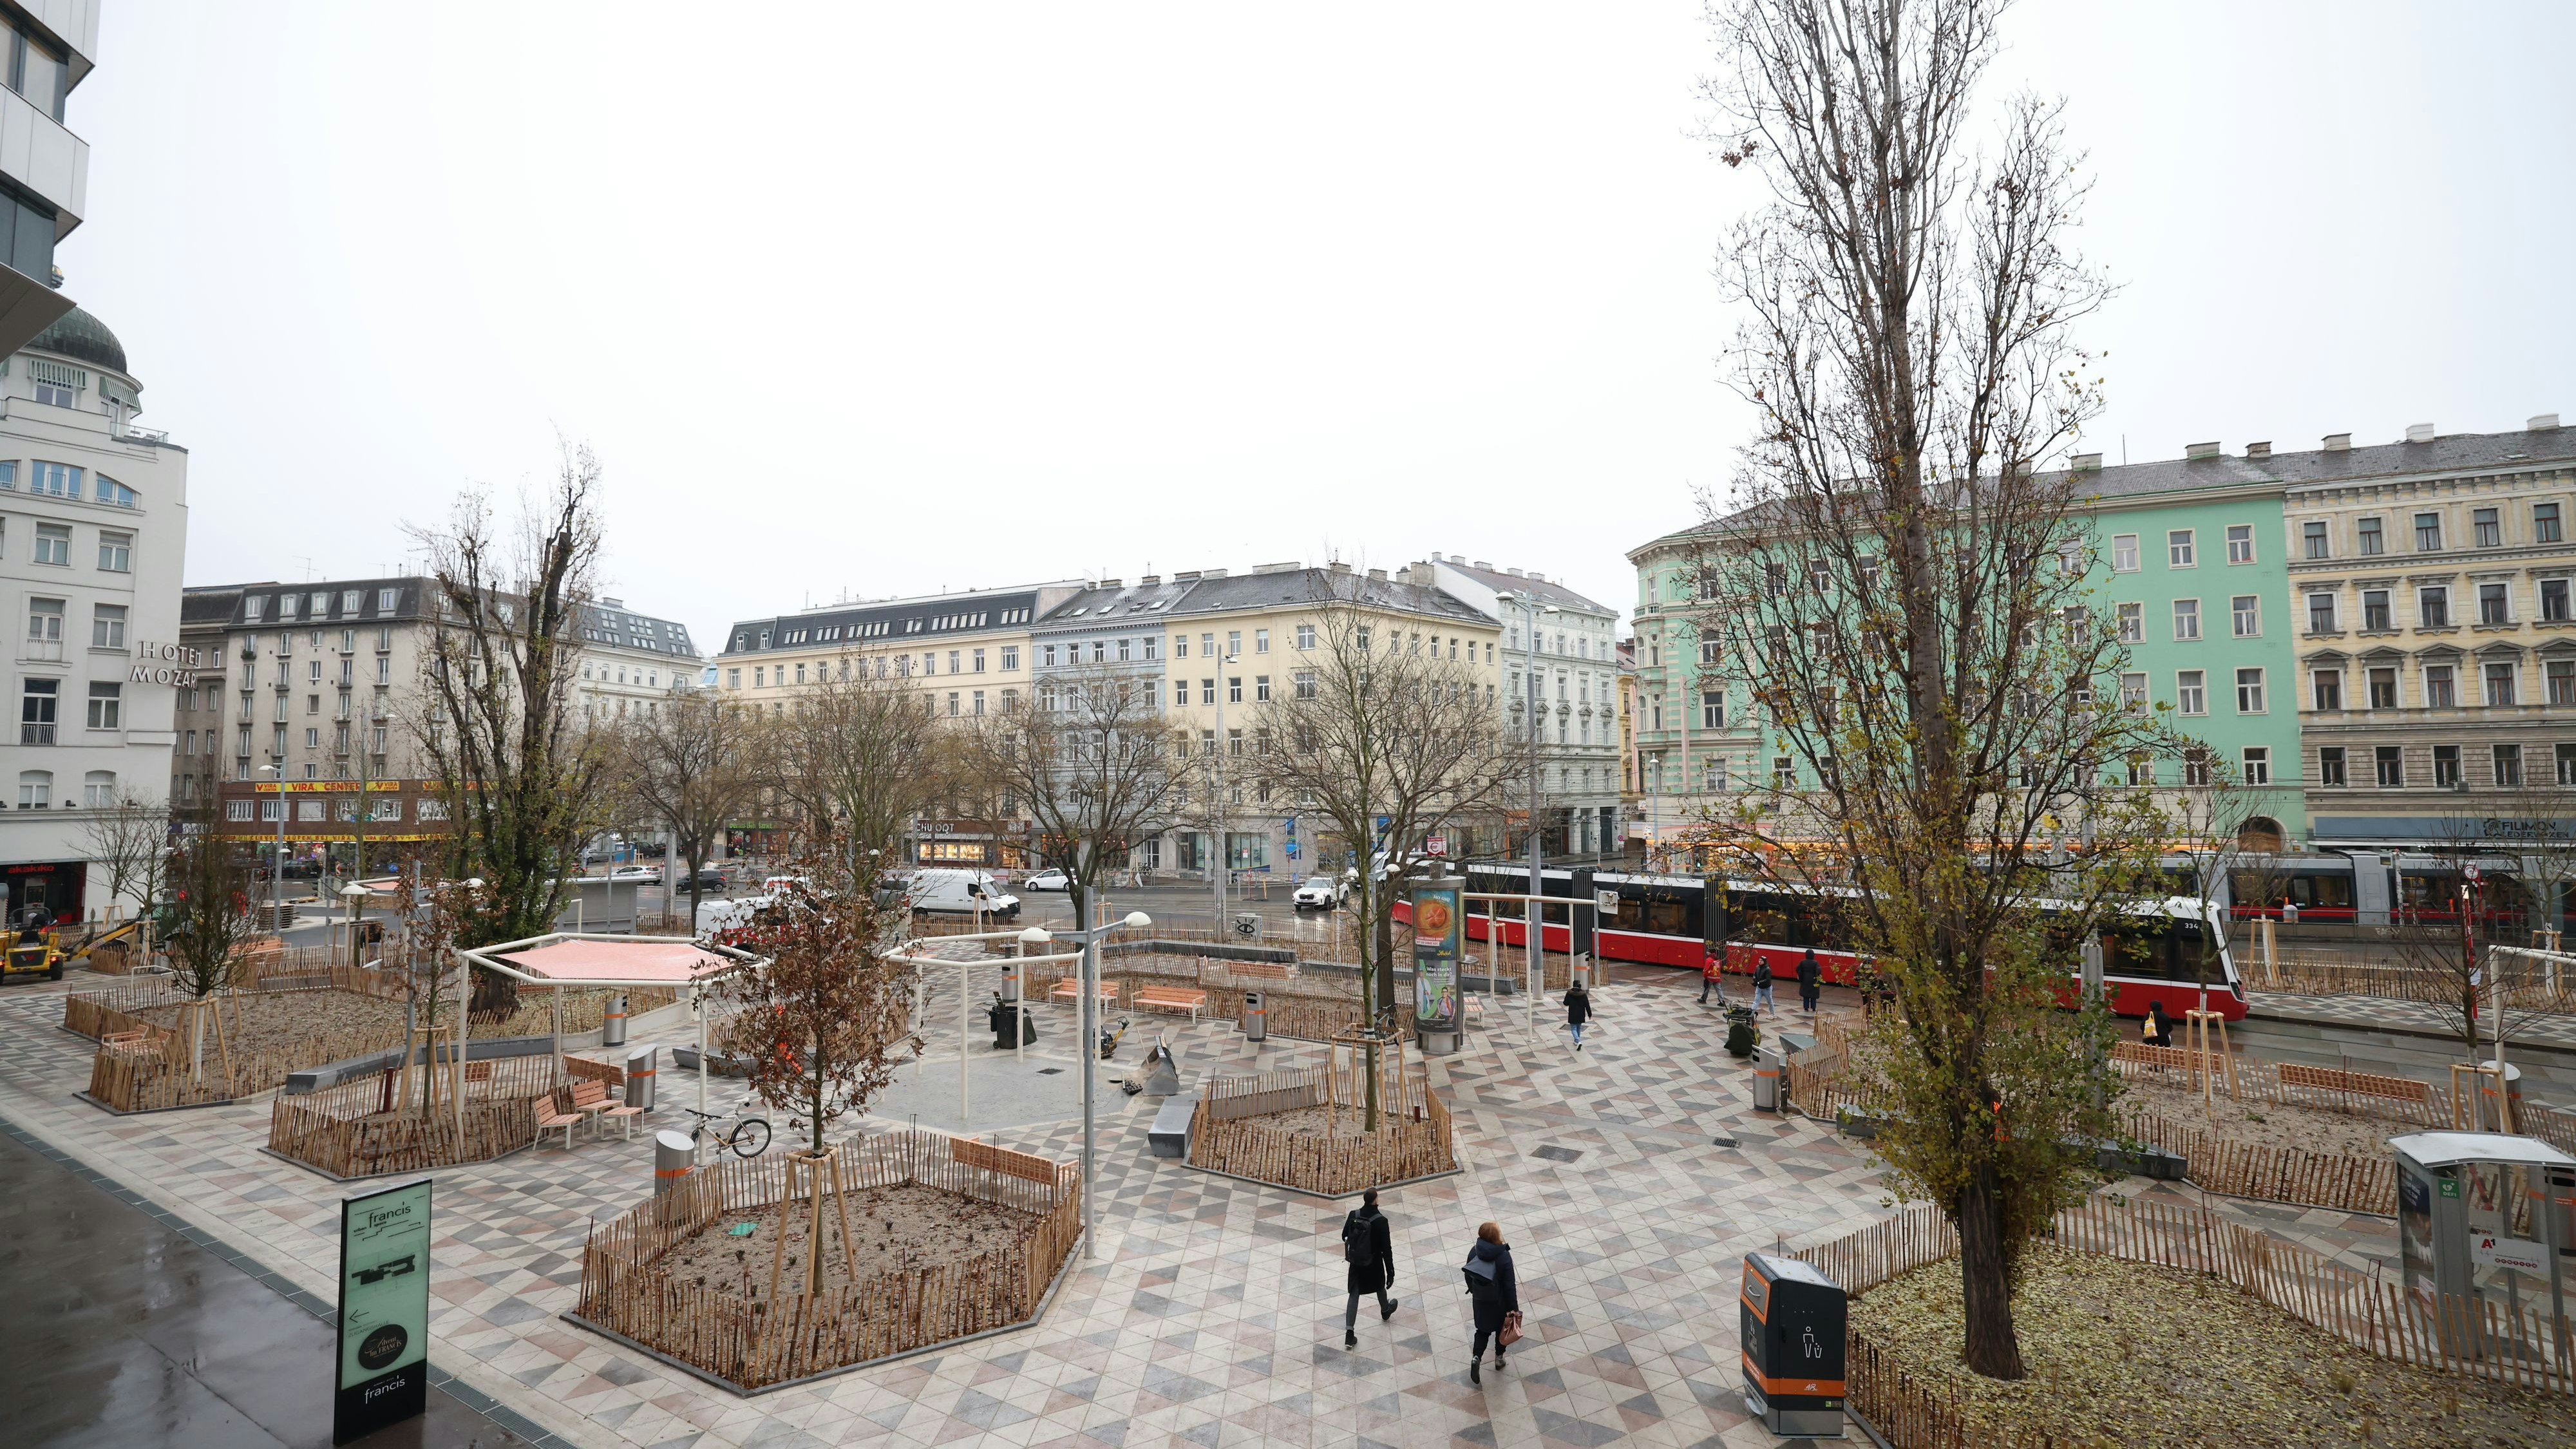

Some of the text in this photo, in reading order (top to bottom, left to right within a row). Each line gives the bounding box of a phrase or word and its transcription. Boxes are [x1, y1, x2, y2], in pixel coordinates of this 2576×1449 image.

[130, 666, 198, 688] MOZAR
[324, 782, 361, 791] CENTER
[2502, 822, 2556, 831] FILIMON
[8, 865, 55, 873] akakiko
[368, 1201, 412, 1228] francis
[379, 1340, 402, 1353] FRANCIS
[365, 1374, 406, 1405] francis
